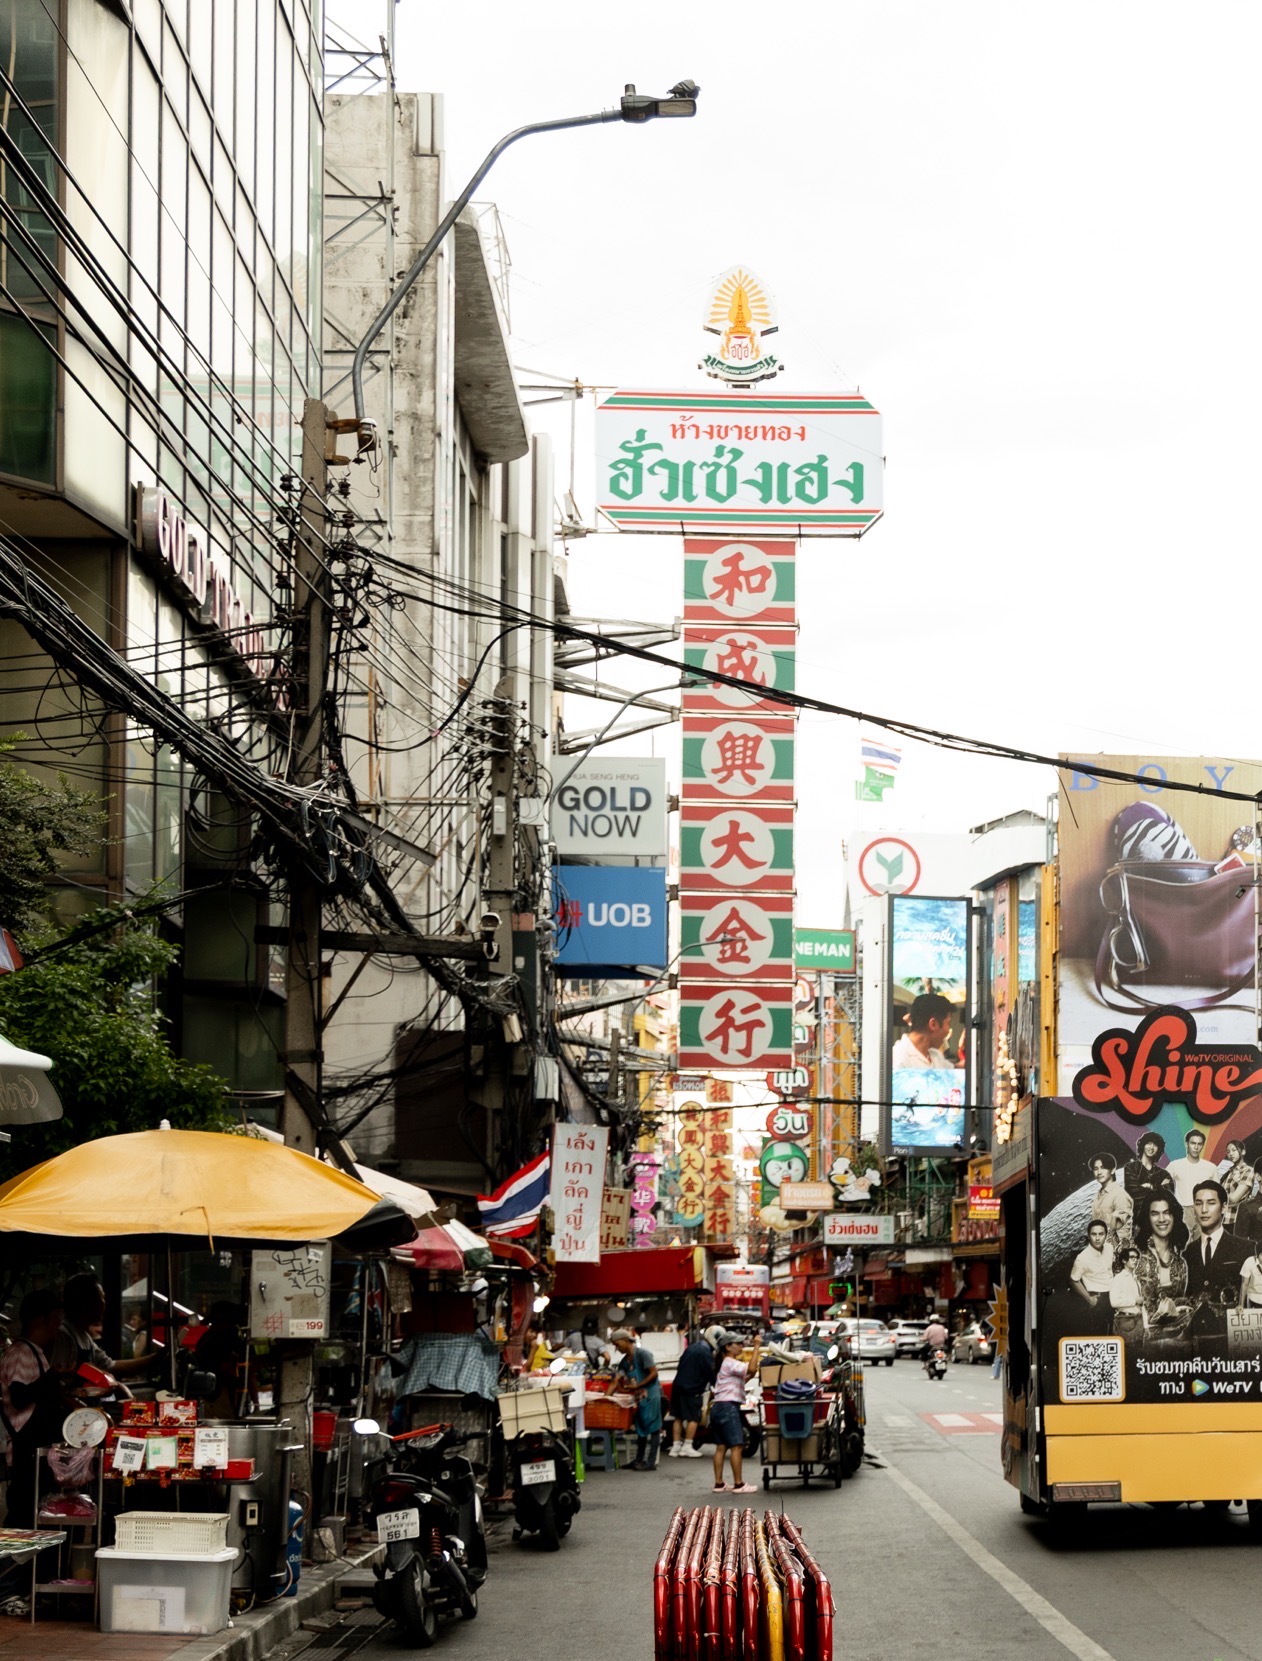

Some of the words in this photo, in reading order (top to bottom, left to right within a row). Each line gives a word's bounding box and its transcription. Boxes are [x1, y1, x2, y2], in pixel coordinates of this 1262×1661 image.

[670, 415, 806, 441] ห้างขายทอง
[557, 785, 652, 812] GOLD
[569, 814, 642, 838] NOW
[588, 903, 652, 927] UOB
[814, 943, 850, 957] MAN
[1212, 1054, 1254, 1063] ORIGINAL
[773, 1109, 809, 1135] วัน
[564, 1162, 593, 1175] เกา
[306, 1321, 323, 1330] 199
[1159, 1381, 1185, 1395] ทาง
[1212, 1381, 1252, 1394] WeTV
